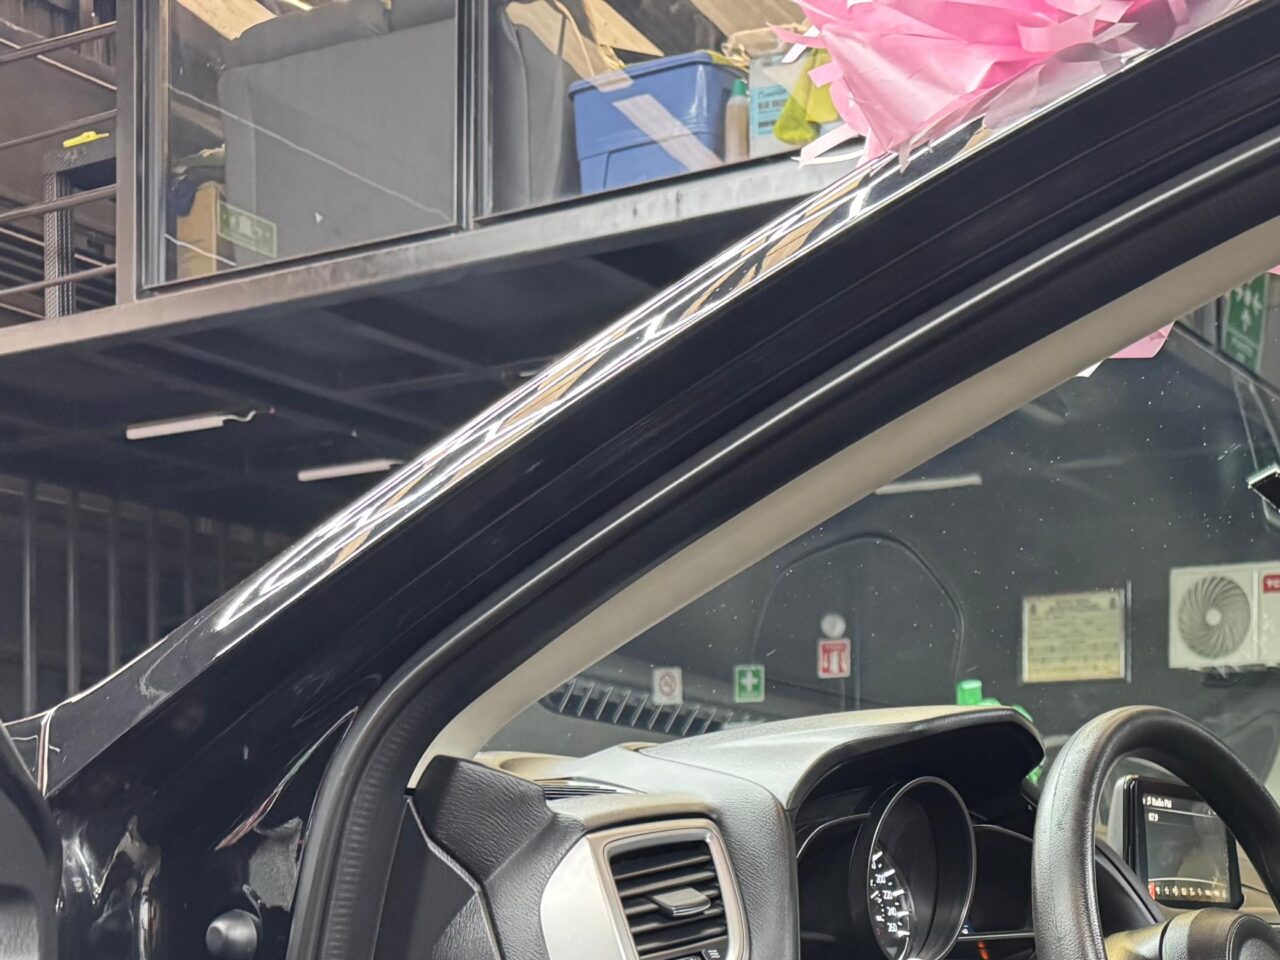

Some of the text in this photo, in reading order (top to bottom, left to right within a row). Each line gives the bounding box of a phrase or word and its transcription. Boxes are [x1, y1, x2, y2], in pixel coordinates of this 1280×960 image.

[875, 873, 886, 884] 200
[882, 889, 893, 900] 220
[887, 906, 897, 916] 240
[887, 922, 898, 933] 260
